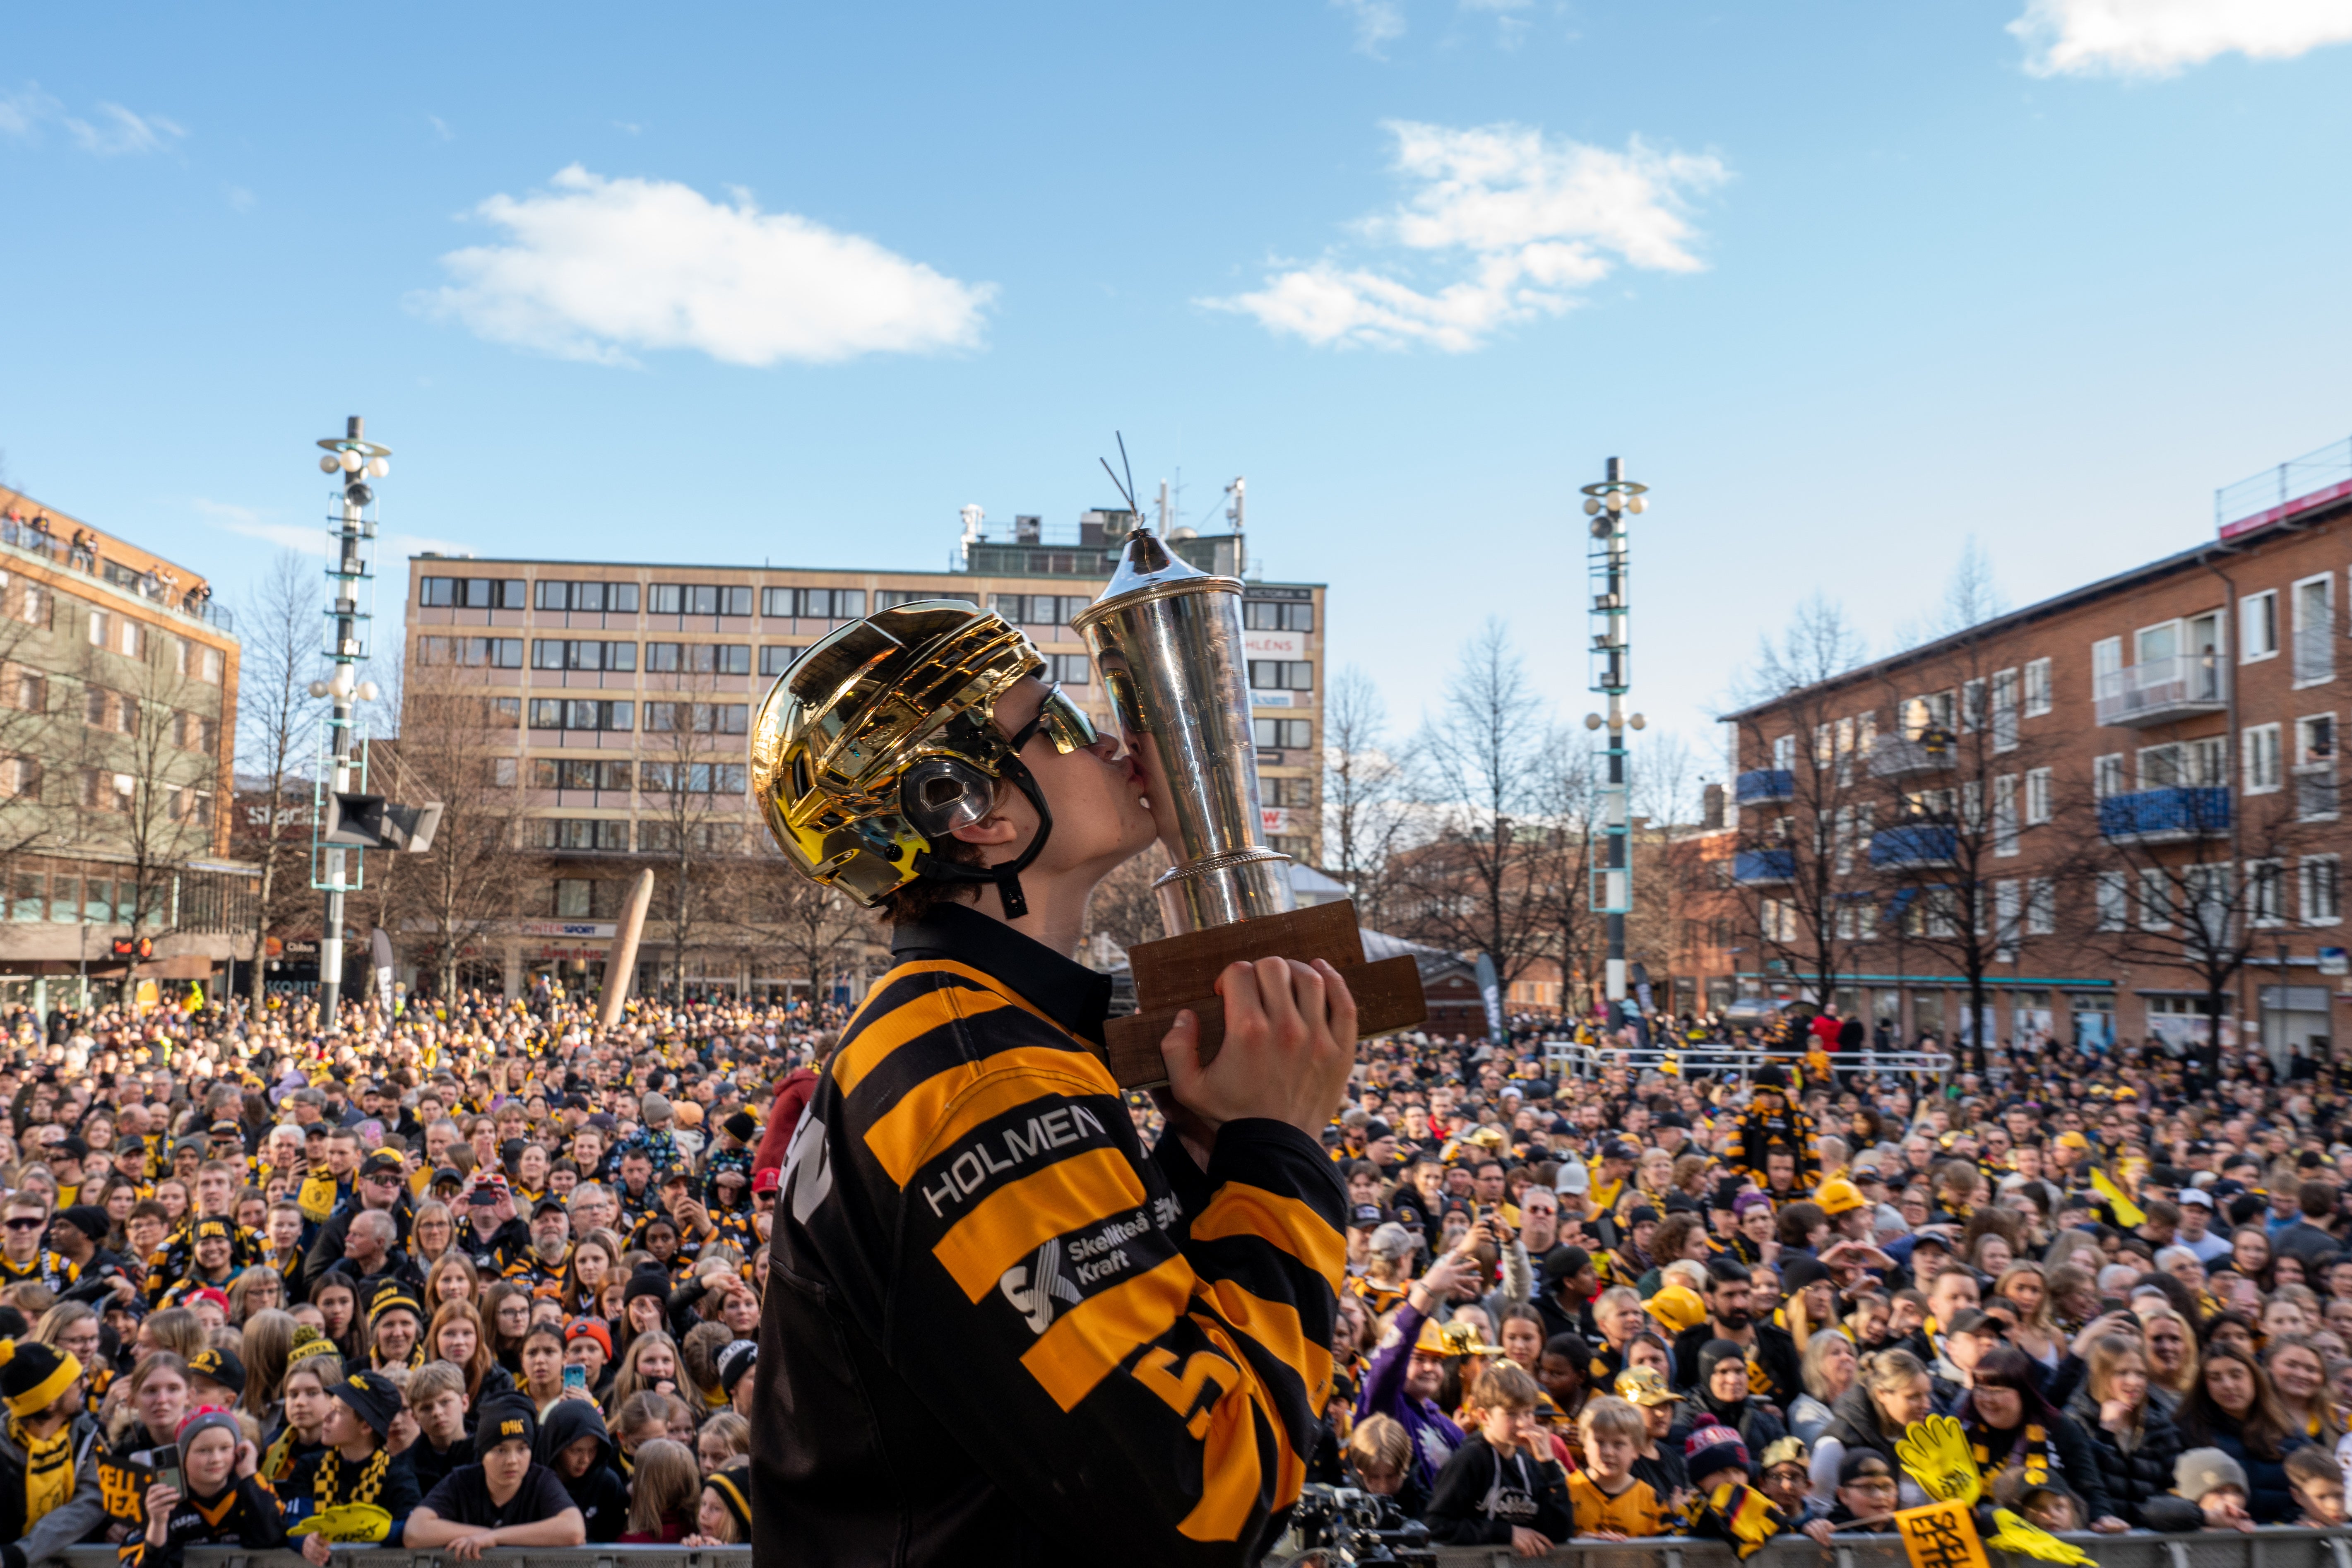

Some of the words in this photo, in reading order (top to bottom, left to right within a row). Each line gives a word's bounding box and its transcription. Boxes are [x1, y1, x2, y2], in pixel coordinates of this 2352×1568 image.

[1246, 640, 1292, 651] HLÉNS
[922, 1104, 1106, 1218] HOLMEN
[1400, 1210, 1413, 1222] S
[1075, 1249, 1130, 1286] Kraft
